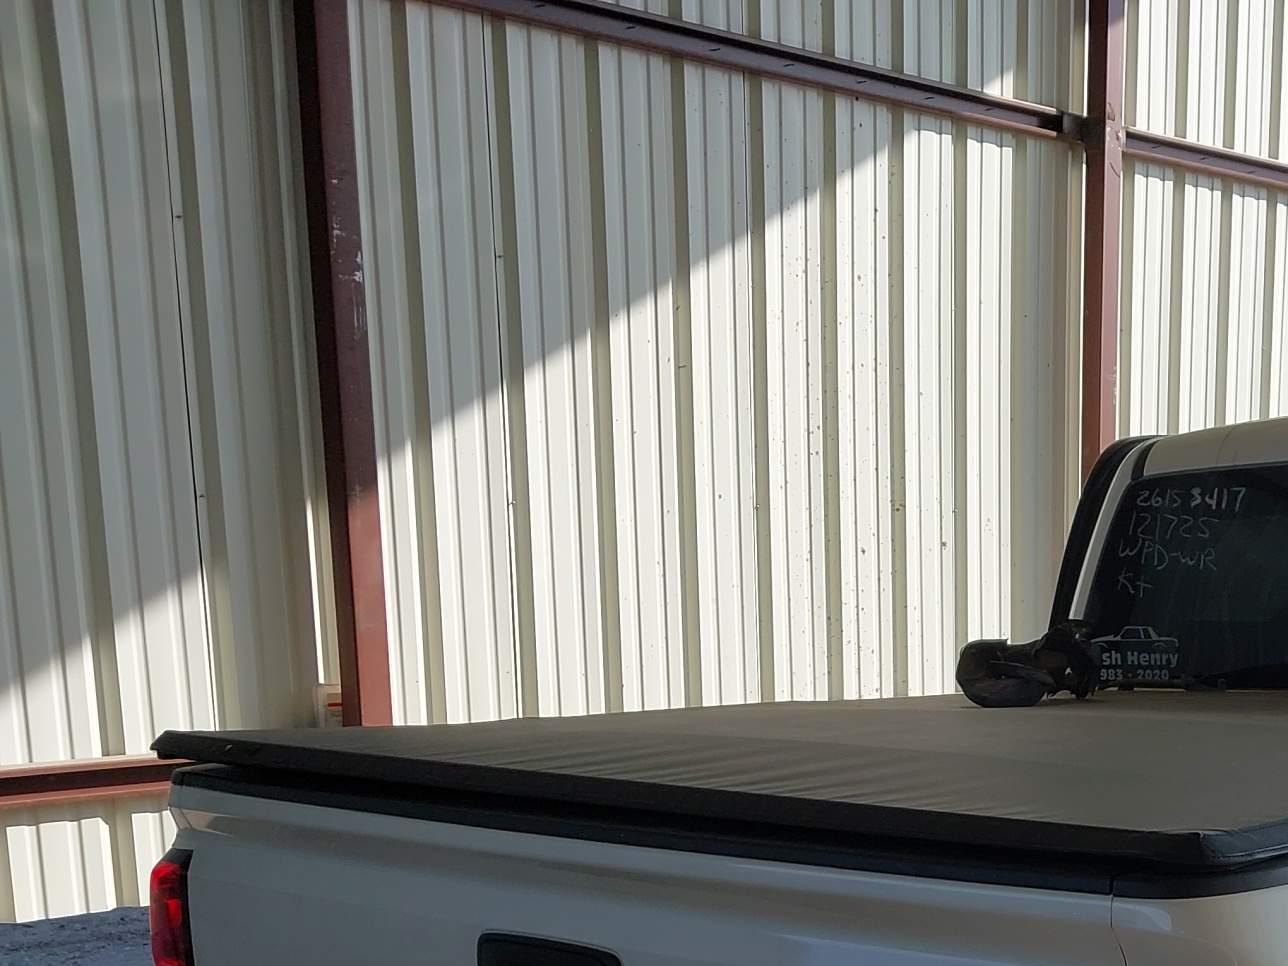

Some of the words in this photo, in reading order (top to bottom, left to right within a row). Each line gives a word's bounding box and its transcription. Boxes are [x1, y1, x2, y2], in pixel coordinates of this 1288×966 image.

[1101, 650, 1122, 666] sh
[1127, 651, 1179, 668] Henry
[1099, 669, 1123, 681] 983
[1136, 669, 1169, 681] 2020
